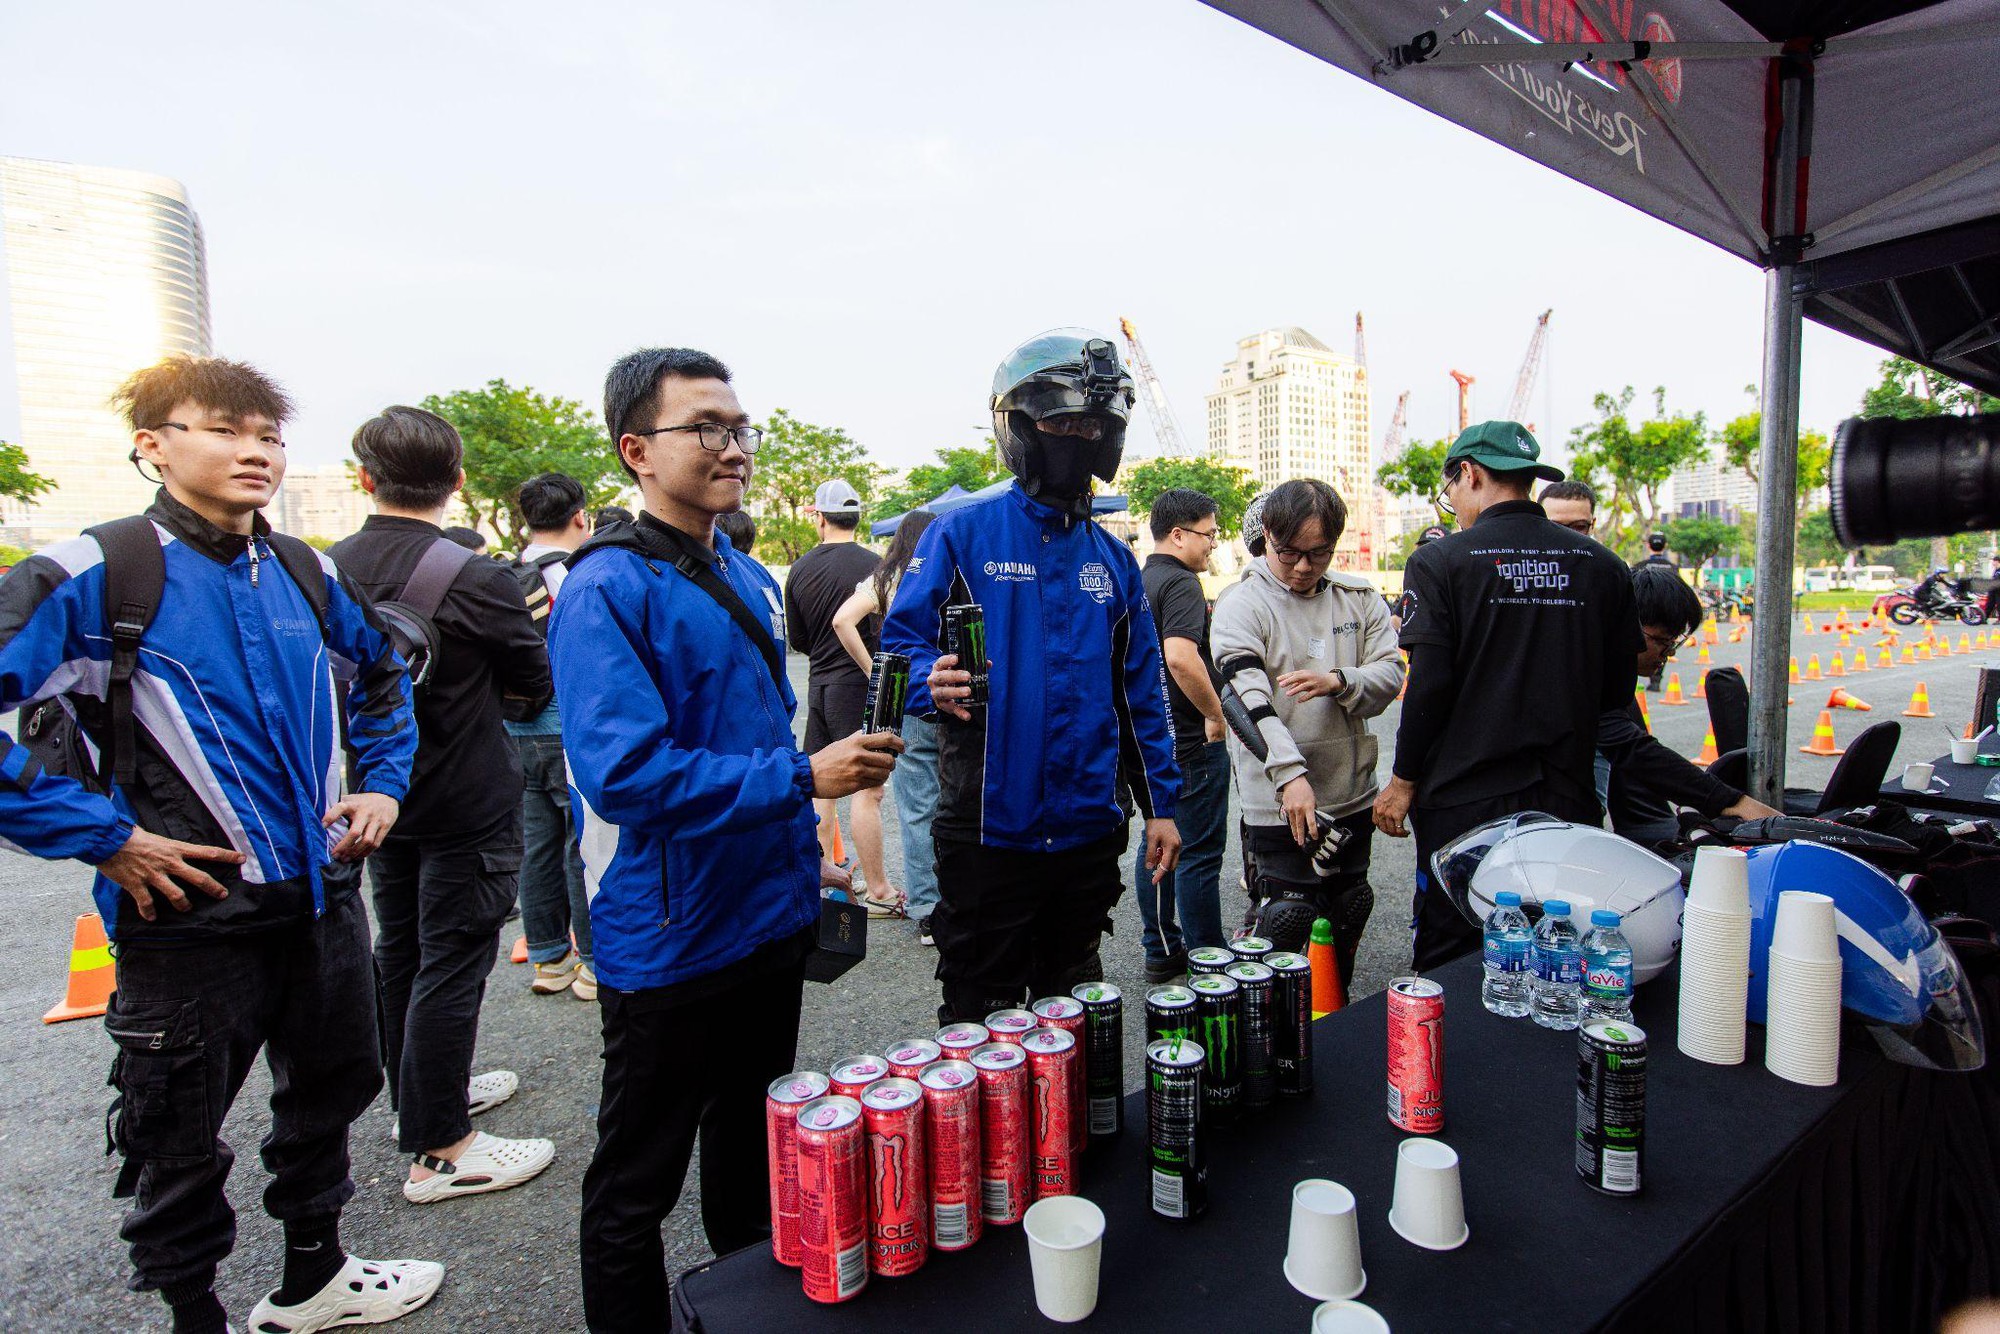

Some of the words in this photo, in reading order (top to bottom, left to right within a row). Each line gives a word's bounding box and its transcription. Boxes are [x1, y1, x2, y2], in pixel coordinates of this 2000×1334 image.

[996, 562, 1037, 576] YAMAHA
[1496, 558, 1560, 580] ignition
[1512, 574, 1570, 593] group
[1588, 970, 1624, 987] laVie
